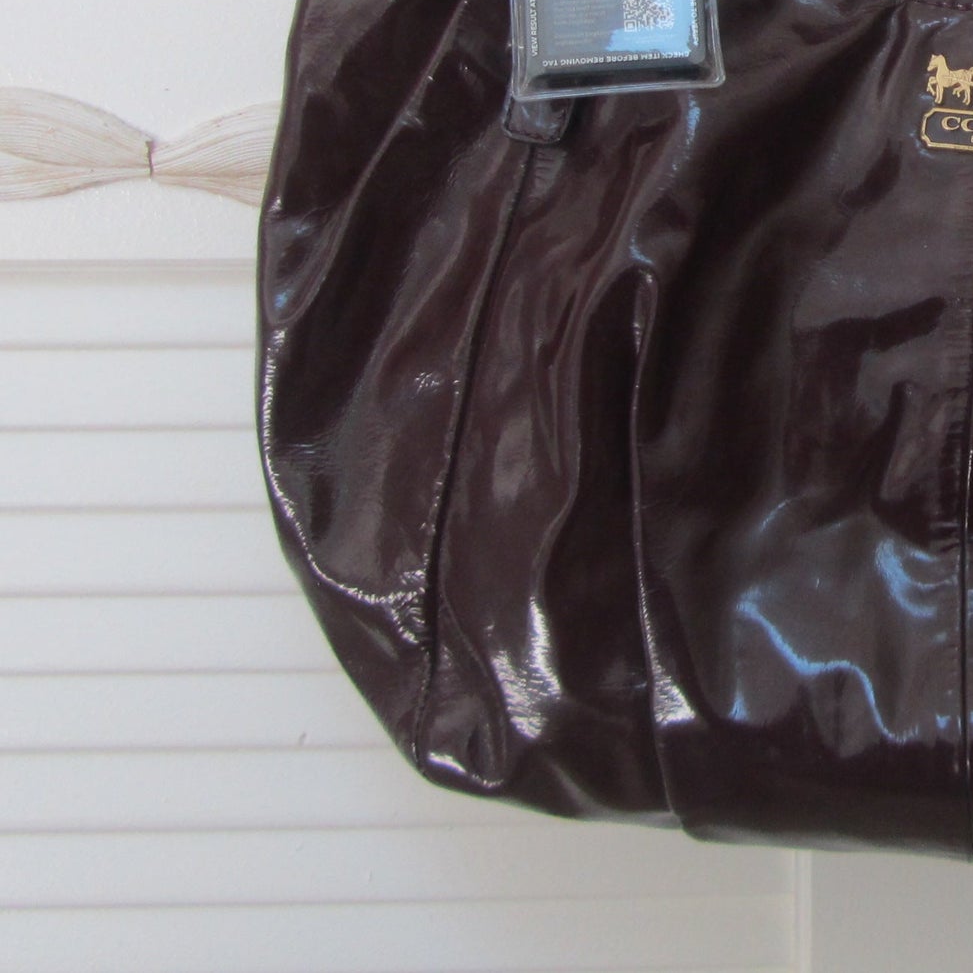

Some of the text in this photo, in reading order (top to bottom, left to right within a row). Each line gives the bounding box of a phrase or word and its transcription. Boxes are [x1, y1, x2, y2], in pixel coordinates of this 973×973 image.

[530, 8, 538, 36] RESULT
[531, 37, 539, 57] VIEW
[542, 50, 690, 67] CHECK ITEM BEFORE REMOVING TAG
